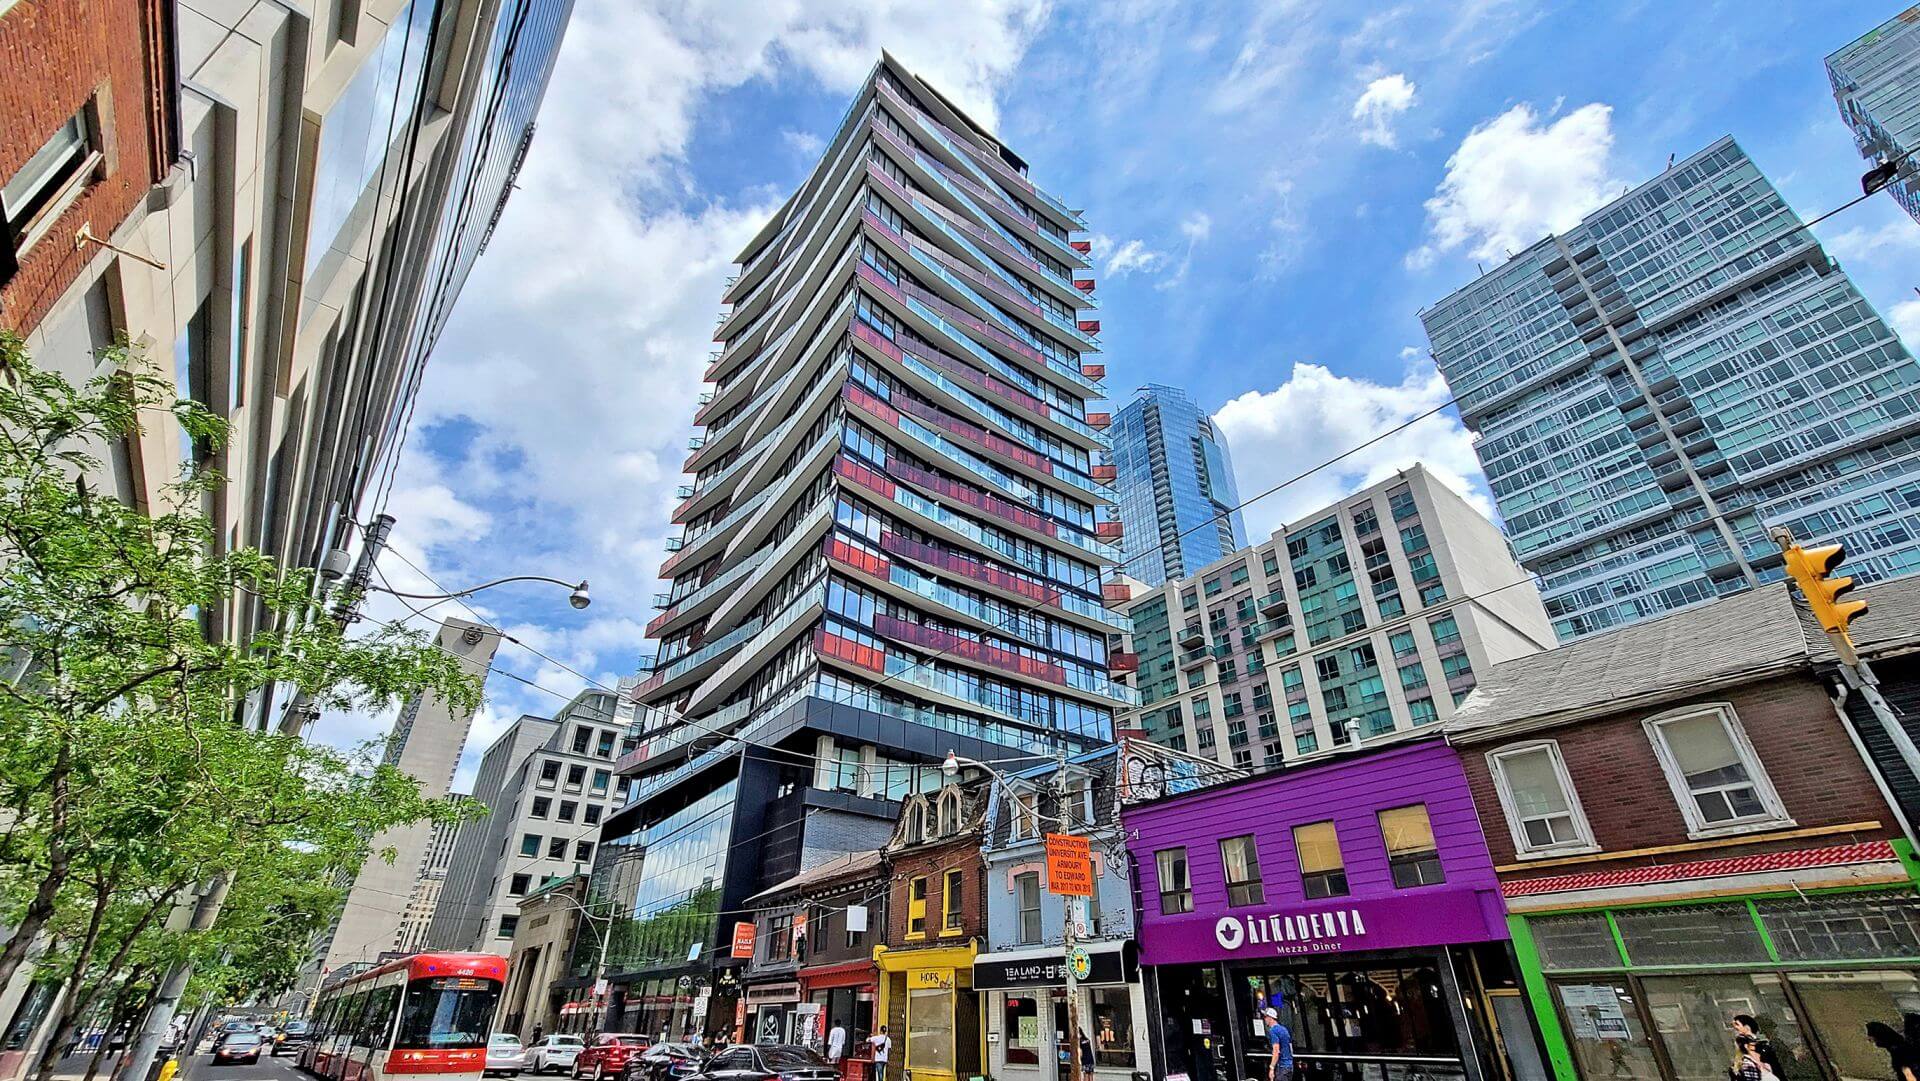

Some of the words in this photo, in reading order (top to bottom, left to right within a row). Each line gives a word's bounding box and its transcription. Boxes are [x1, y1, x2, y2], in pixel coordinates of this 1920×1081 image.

[1049, 837, 1088, 849] CONSTRUCTION
[1049, 848, 1077, 859] UNIVERSITY
[1057, 860, 1082, 870] ARMOURY
[1055, 870, 1063, 880] TO
[1064, 871, 1086, 881] EDWARD
[1277, 944, 1309, 954] Mezza
[1312, 942, 1342, 952] Diner
[1005, 967, 1020, 977] TEA
[1020, 965, 1041, 976] LAND
[920, 972, 939, 984] HOPS
